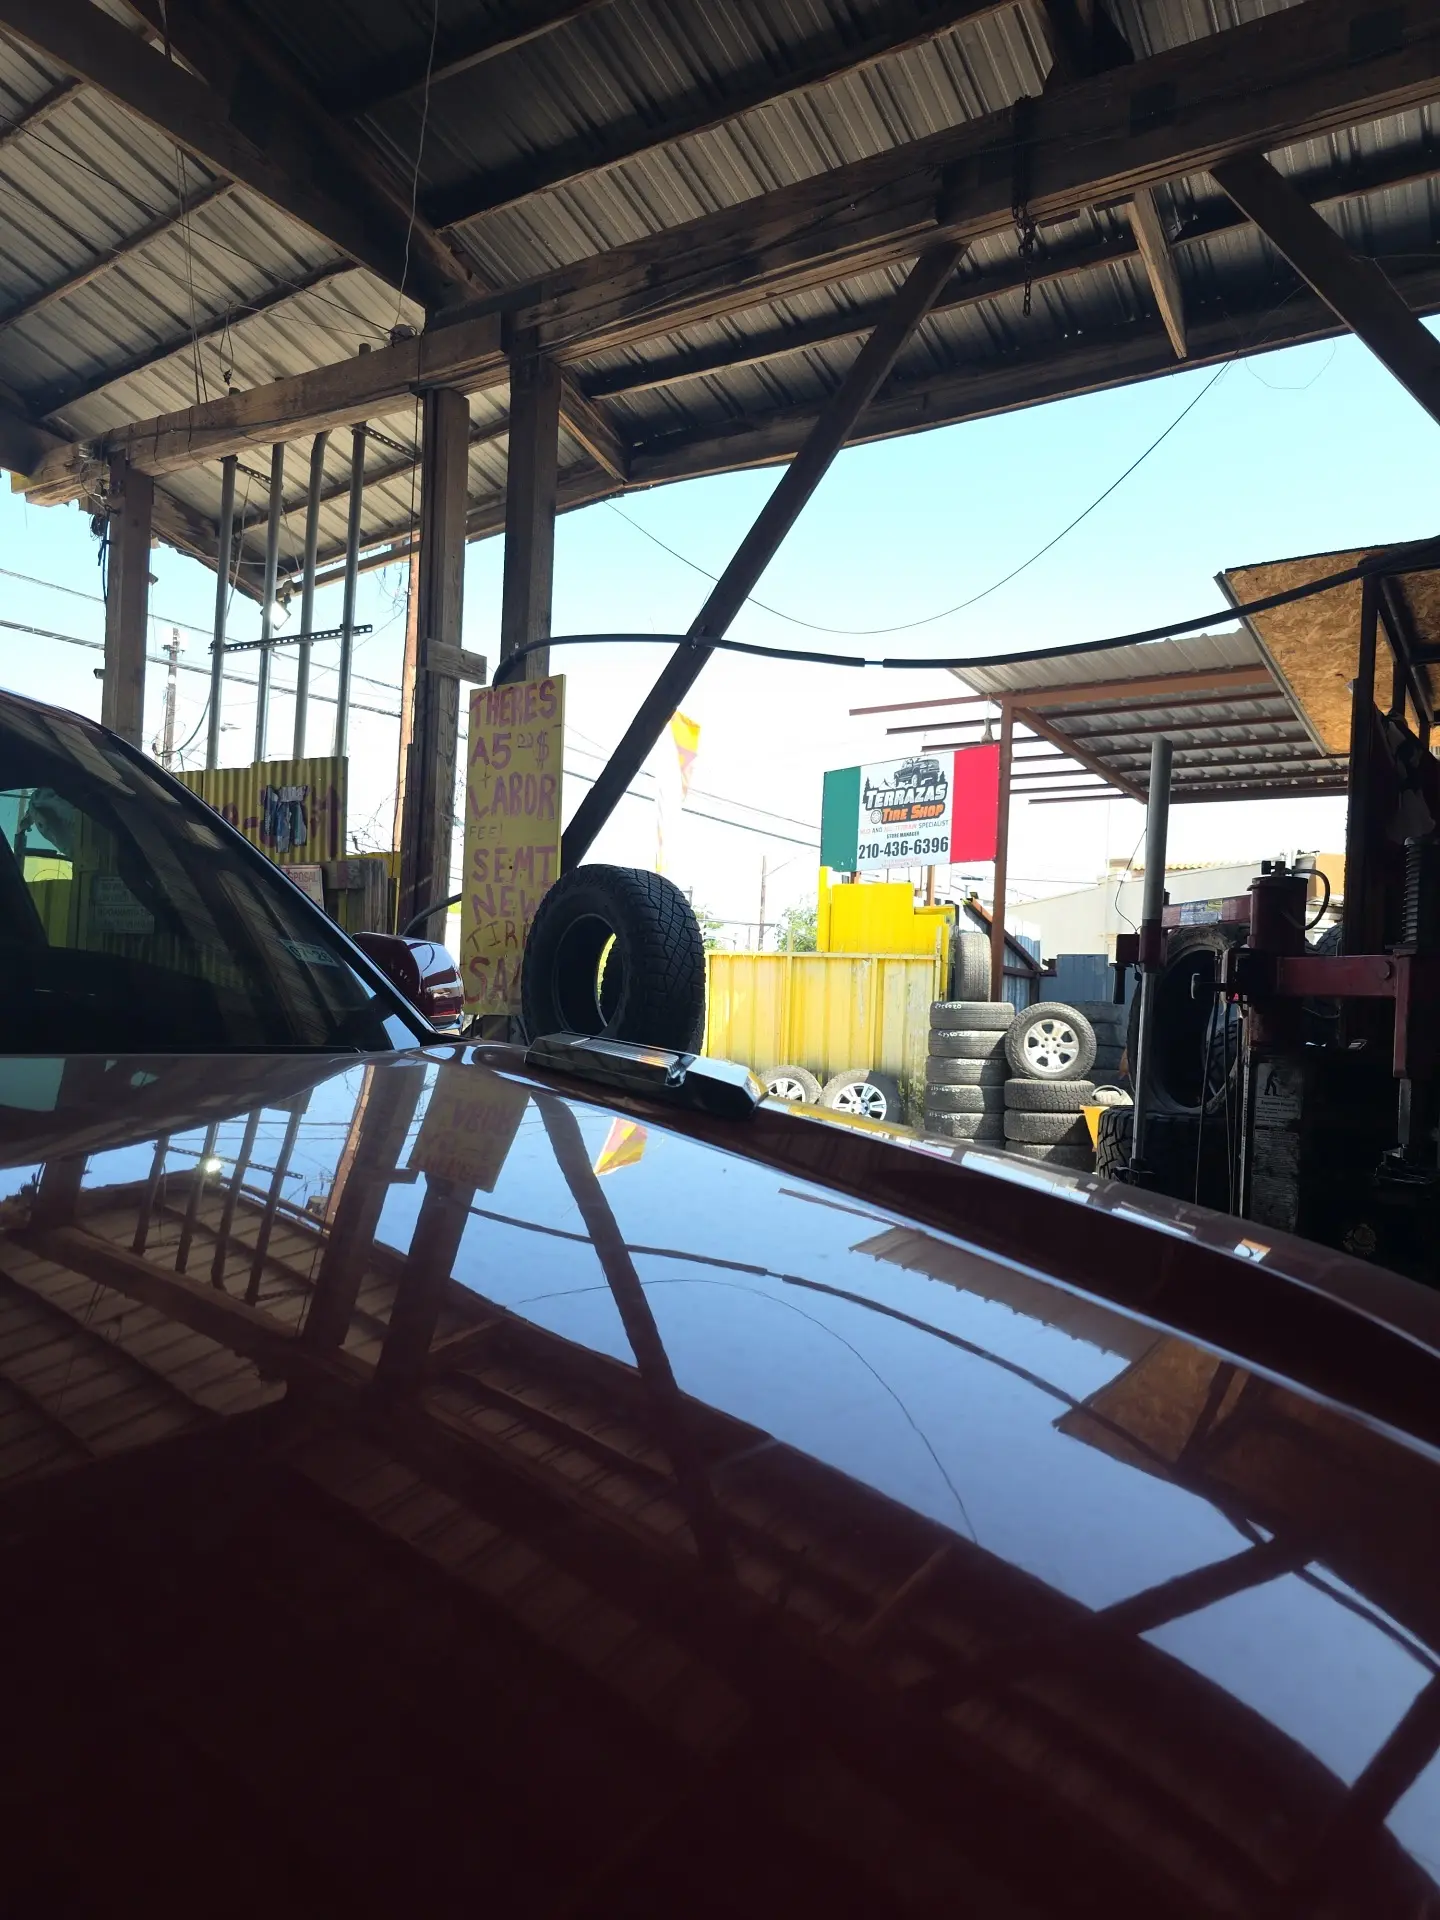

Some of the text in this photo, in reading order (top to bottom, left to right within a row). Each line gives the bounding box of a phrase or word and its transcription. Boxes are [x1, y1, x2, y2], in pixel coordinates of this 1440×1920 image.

[469, 679, 558, 728] THERES
[467, 771, 556, 821] LABOR
[866, 784, 947, 809] TERRAZAS
[882, 804, 944, 822] TIRE SHOP
[872, 826, 883, 834] AND
[918, 820, 949, 829] SPECIALIST
[858, 836, 949, 859] 210-436-6396
